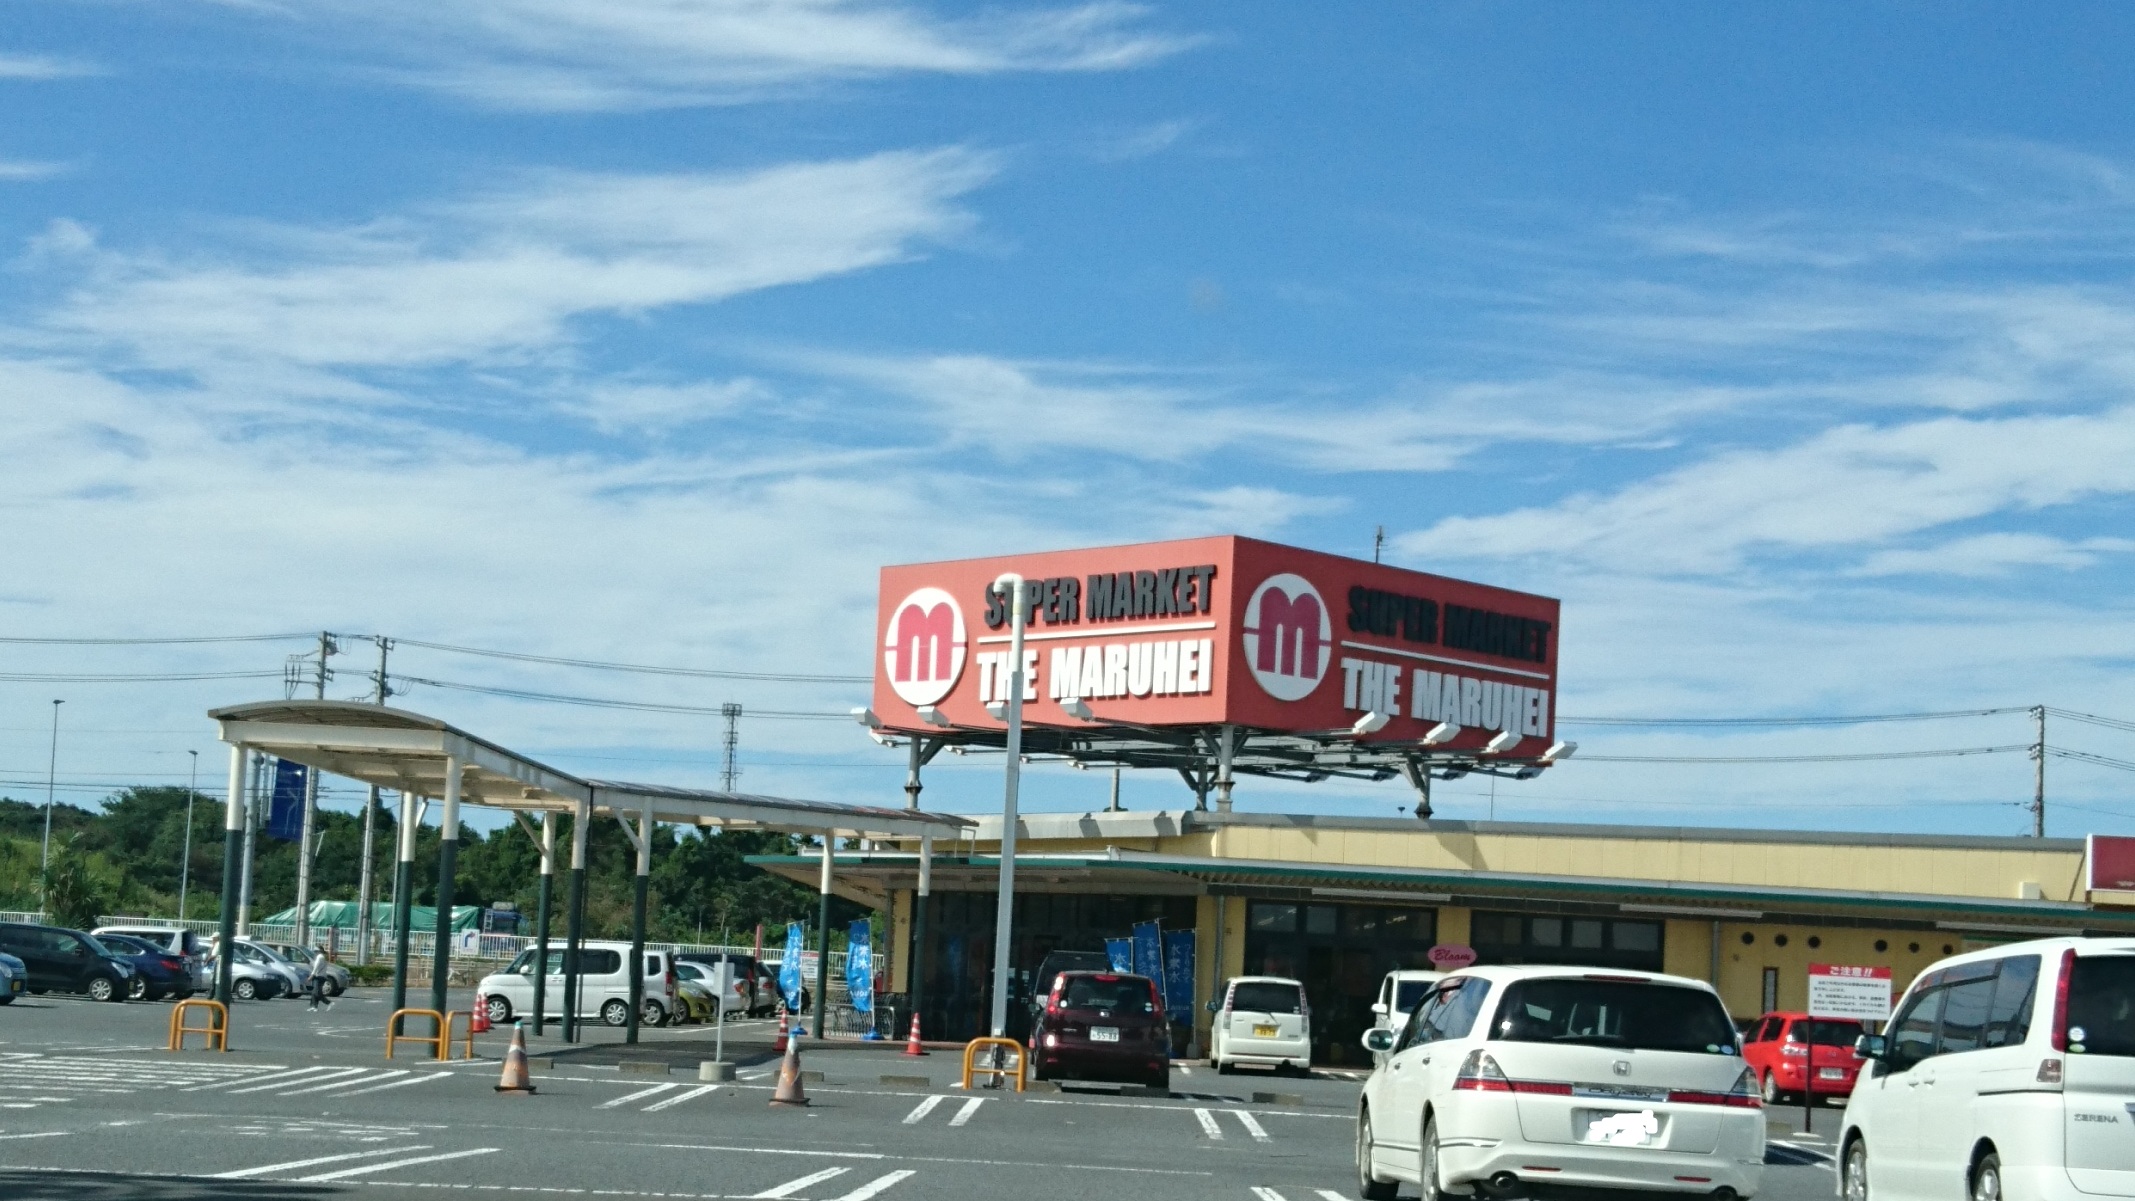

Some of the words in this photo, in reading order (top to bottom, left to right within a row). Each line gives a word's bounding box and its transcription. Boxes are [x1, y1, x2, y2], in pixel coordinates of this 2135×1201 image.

[1086, 564, 1216, 622] MARKET
[1347, 583, 1438, 644] SUPER
[1443, 603, 1551, 664] MARKET
[1050, 638, 1212, 699] MARUHEI
[1341, 657, 1401, 716] THE
[1411, 669, 1549, 738] MARUHEI
[1434, 949, 1471, 961] Bloom
[2074, 1113, 2119, 1123] SERENA
